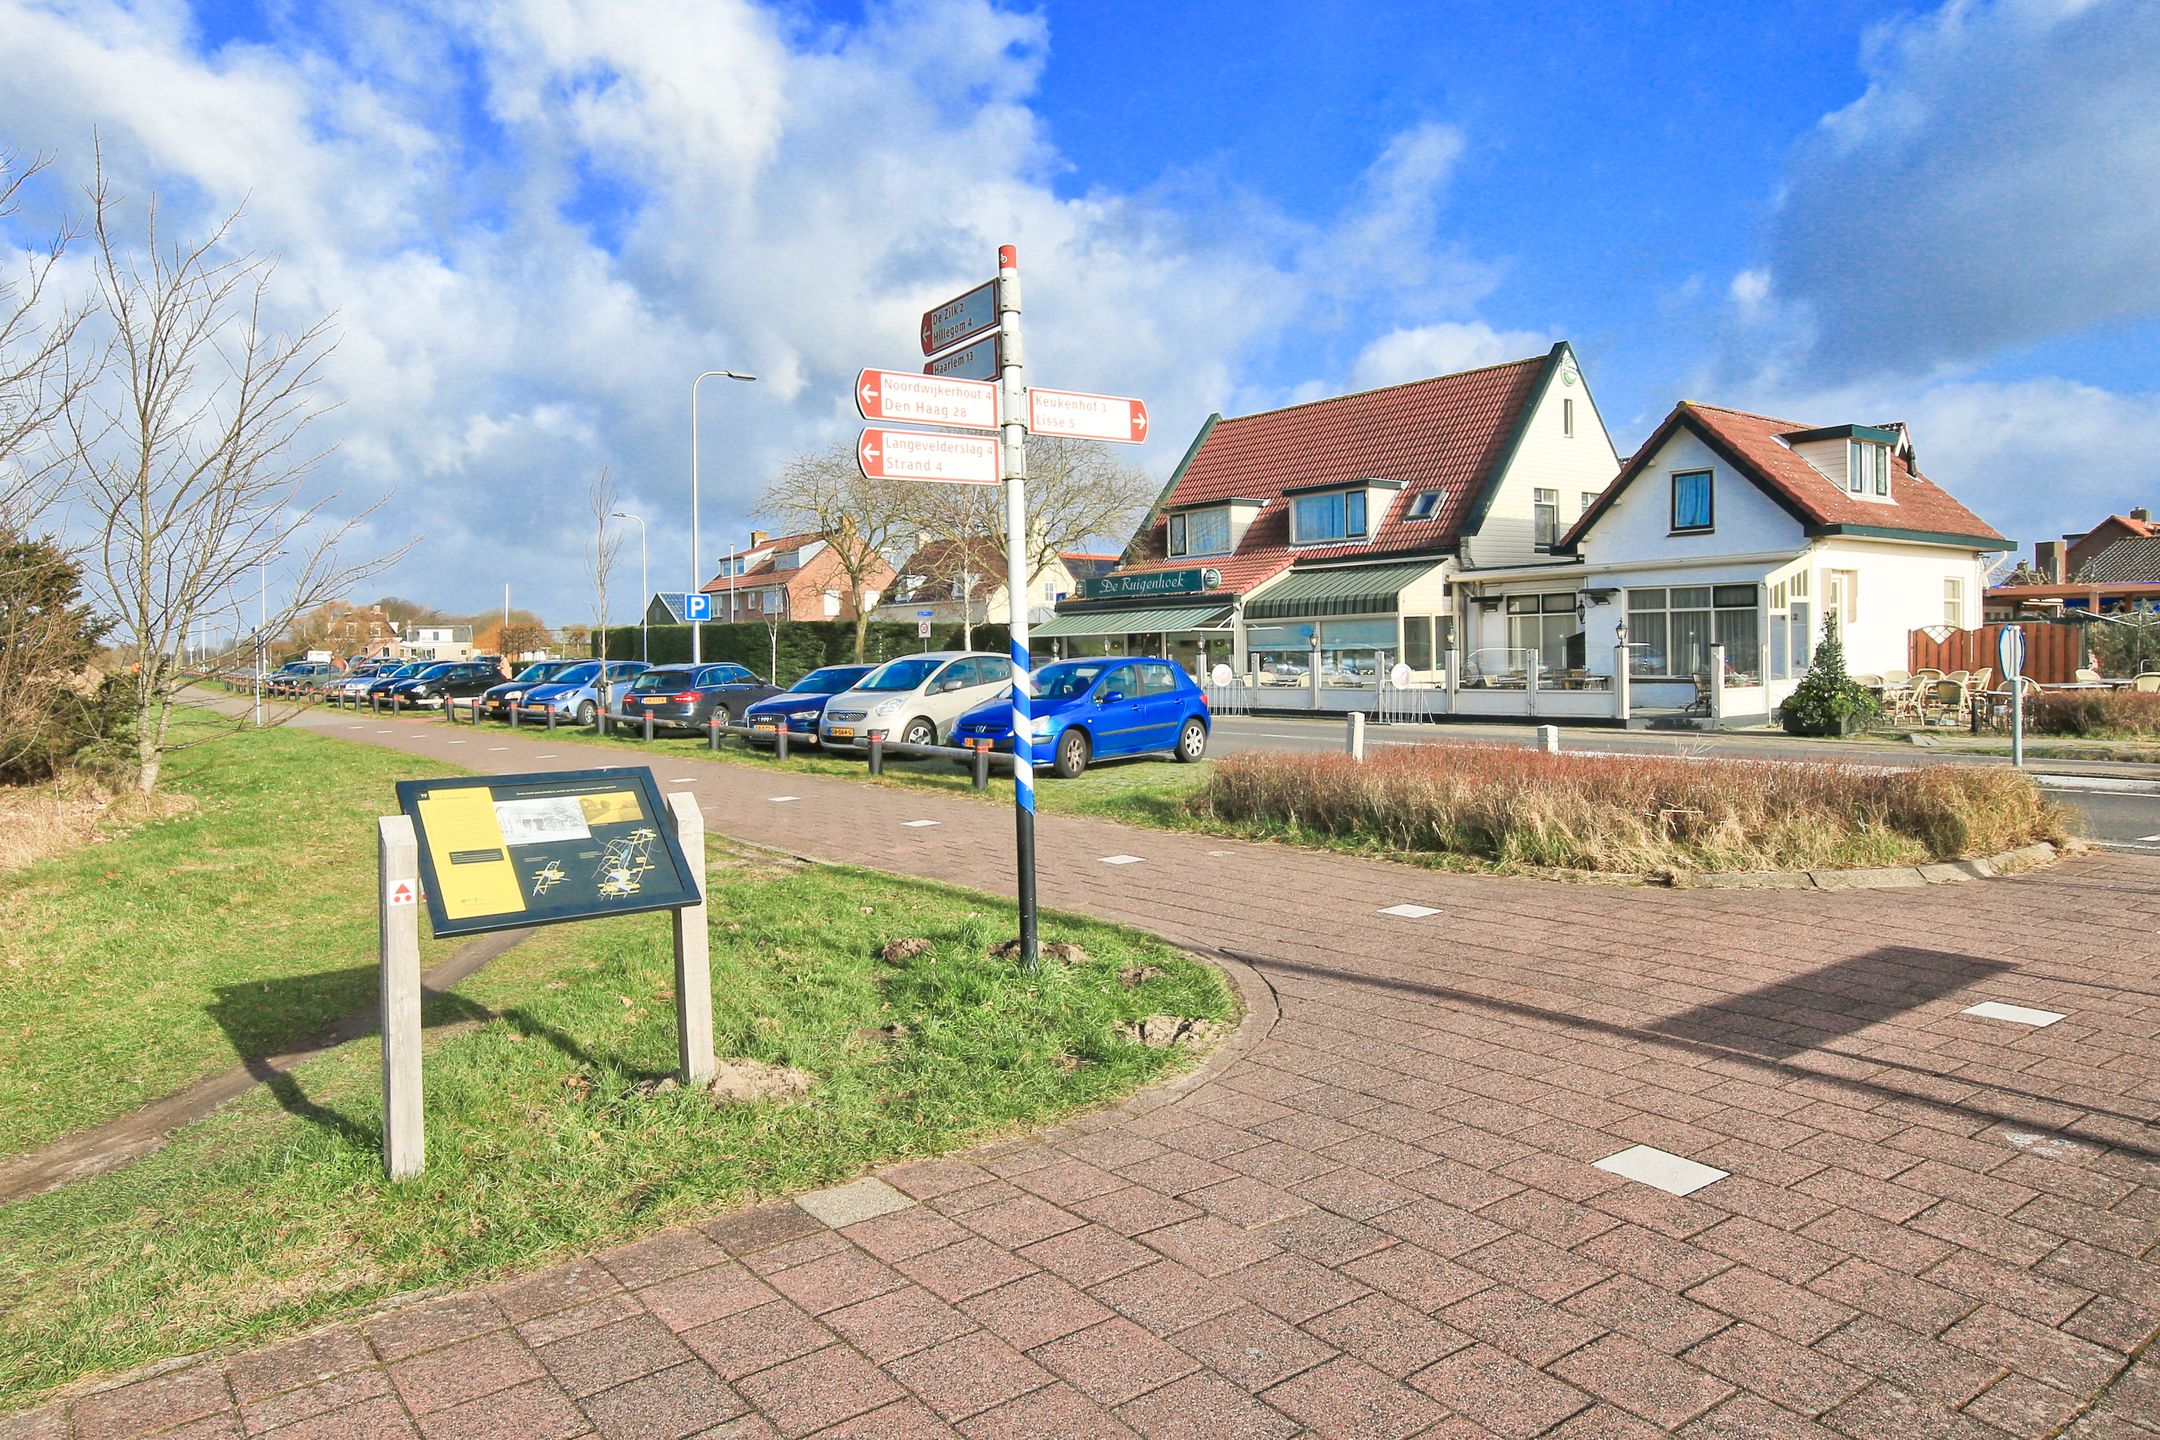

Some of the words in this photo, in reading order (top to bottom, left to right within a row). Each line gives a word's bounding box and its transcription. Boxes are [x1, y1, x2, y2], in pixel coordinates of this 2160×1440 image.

[932, 313, 942, 325] De
[944, 304, 960, 320] Zilk
[959, 303, 964, 313] 2
[933, 321, 966, 343] Hillegom
[967, 317, 973, 327] 4
[934, 355, 965, 375] Haarlem
[966, 351, 974, 362] 13
[884, 378, 983, 399] Noordwijkerhout
[985, 391, 992, 400] 4
[885, 398, 911, 412] Den
[915, 401, 948, 419] Haag
[953, 406, 967, 418] 28
[1035, 395, 1098, 412] Keukenhof
[1101, 403, 1107, 413] 3
[1036, 414, 1065, 428] Lisse
[1069, 418, 1075, 428] 5
[886, 436, 983, 457] Langevelderslag
[986, 446, 993, 455] 4
[886, 456, 931, 471] Strand
[935, 462, 942, 472] 4
[1099, 579, 1118, 593] De
[1121, 571, 1186, 593] Ruigenhoek
[690, 597, 705, 617] P
